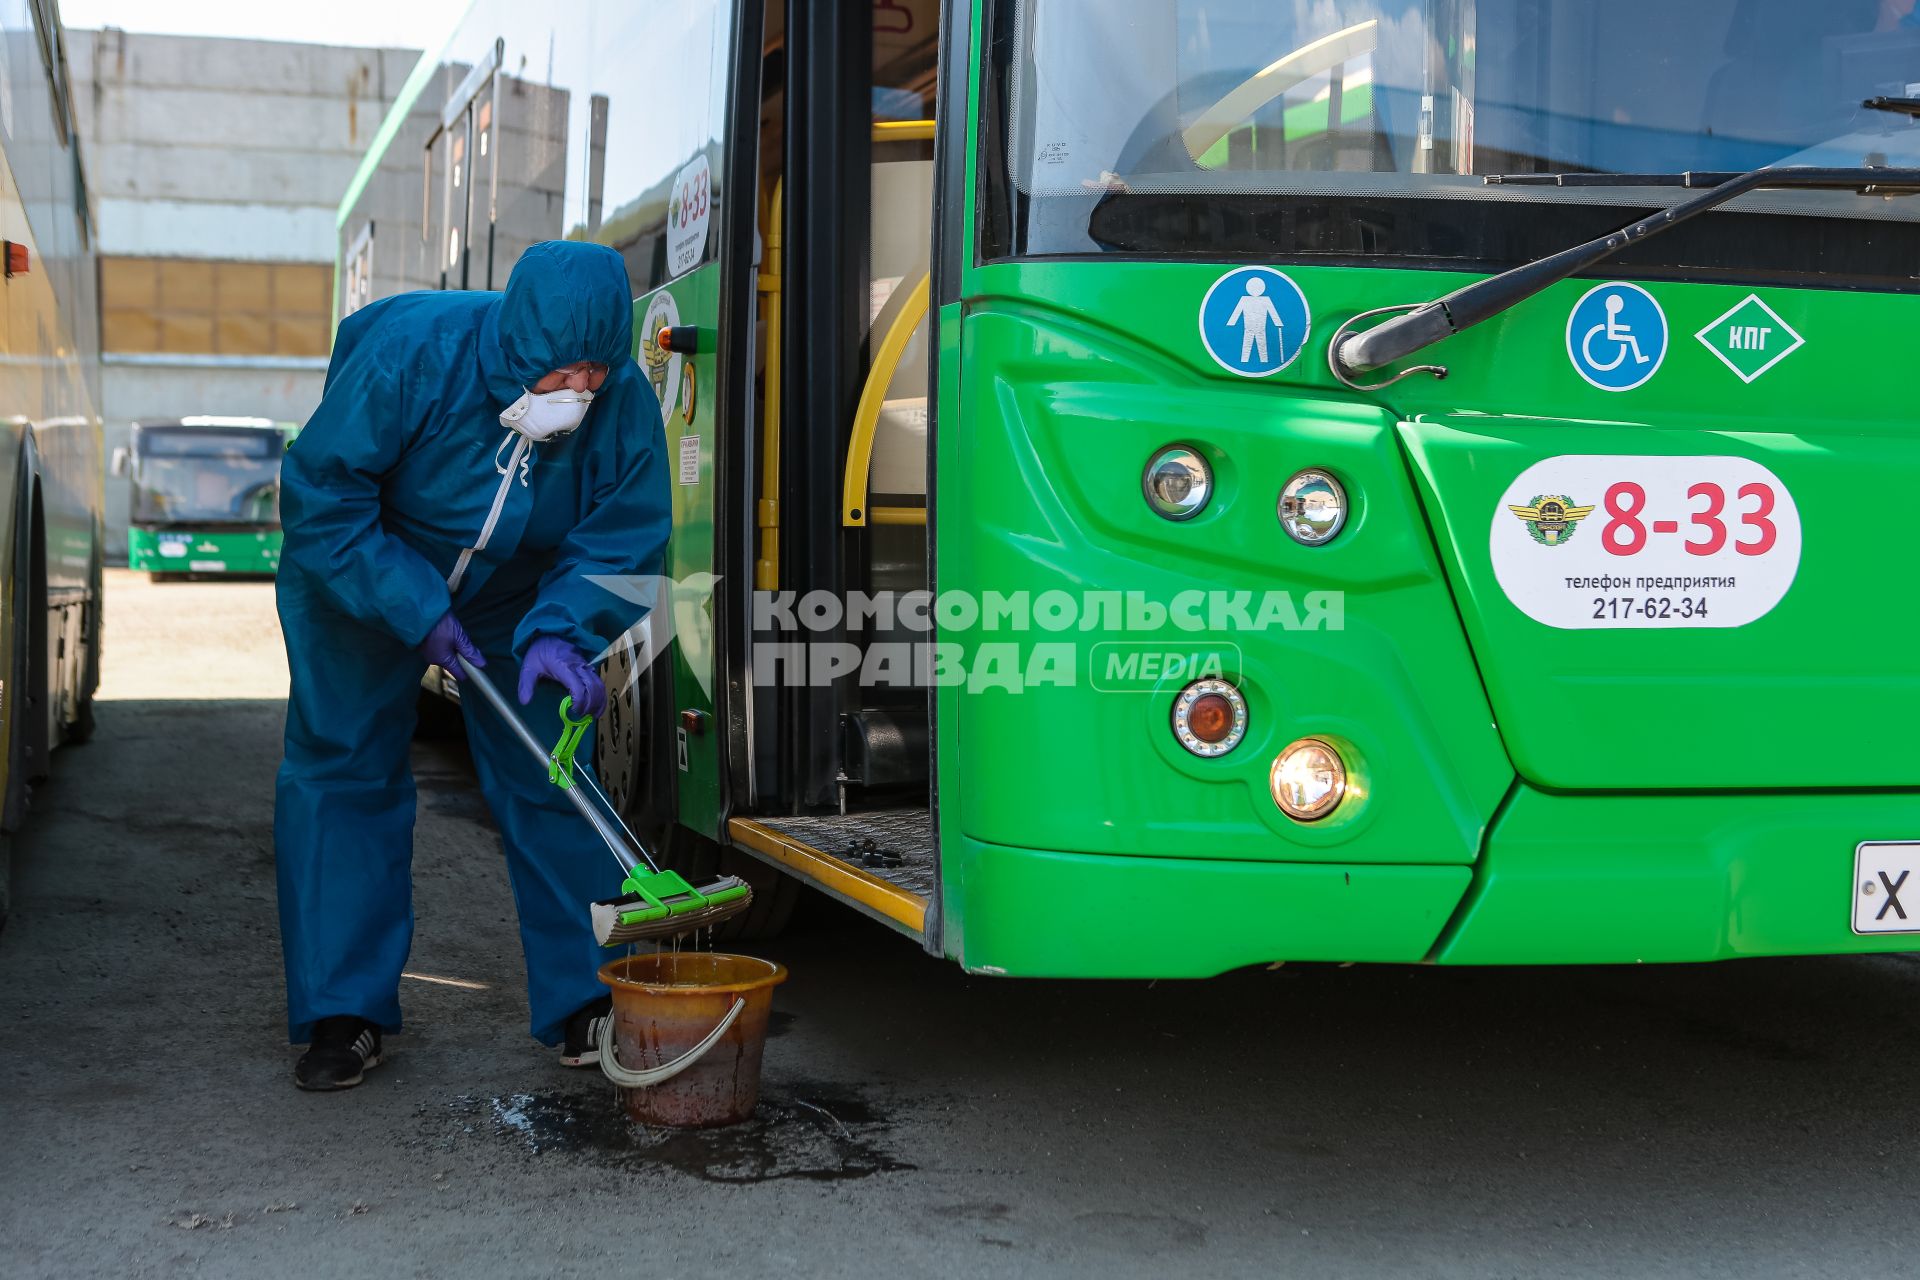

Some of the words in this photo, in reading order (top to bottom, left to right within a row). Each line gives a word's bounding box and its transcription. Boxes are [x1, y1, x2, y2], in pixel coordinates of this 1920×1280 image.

[681, 168, 707, 228] 8-33
[1729, 326, 1771, 350] КПГ
[1601, 481, 1777, 556] 8-33
[1565, 574, 1631, 591] телефон
[1636, 576, 1736, 591] предприятия
[1592, 597, 1708, 619] 217-62-34
